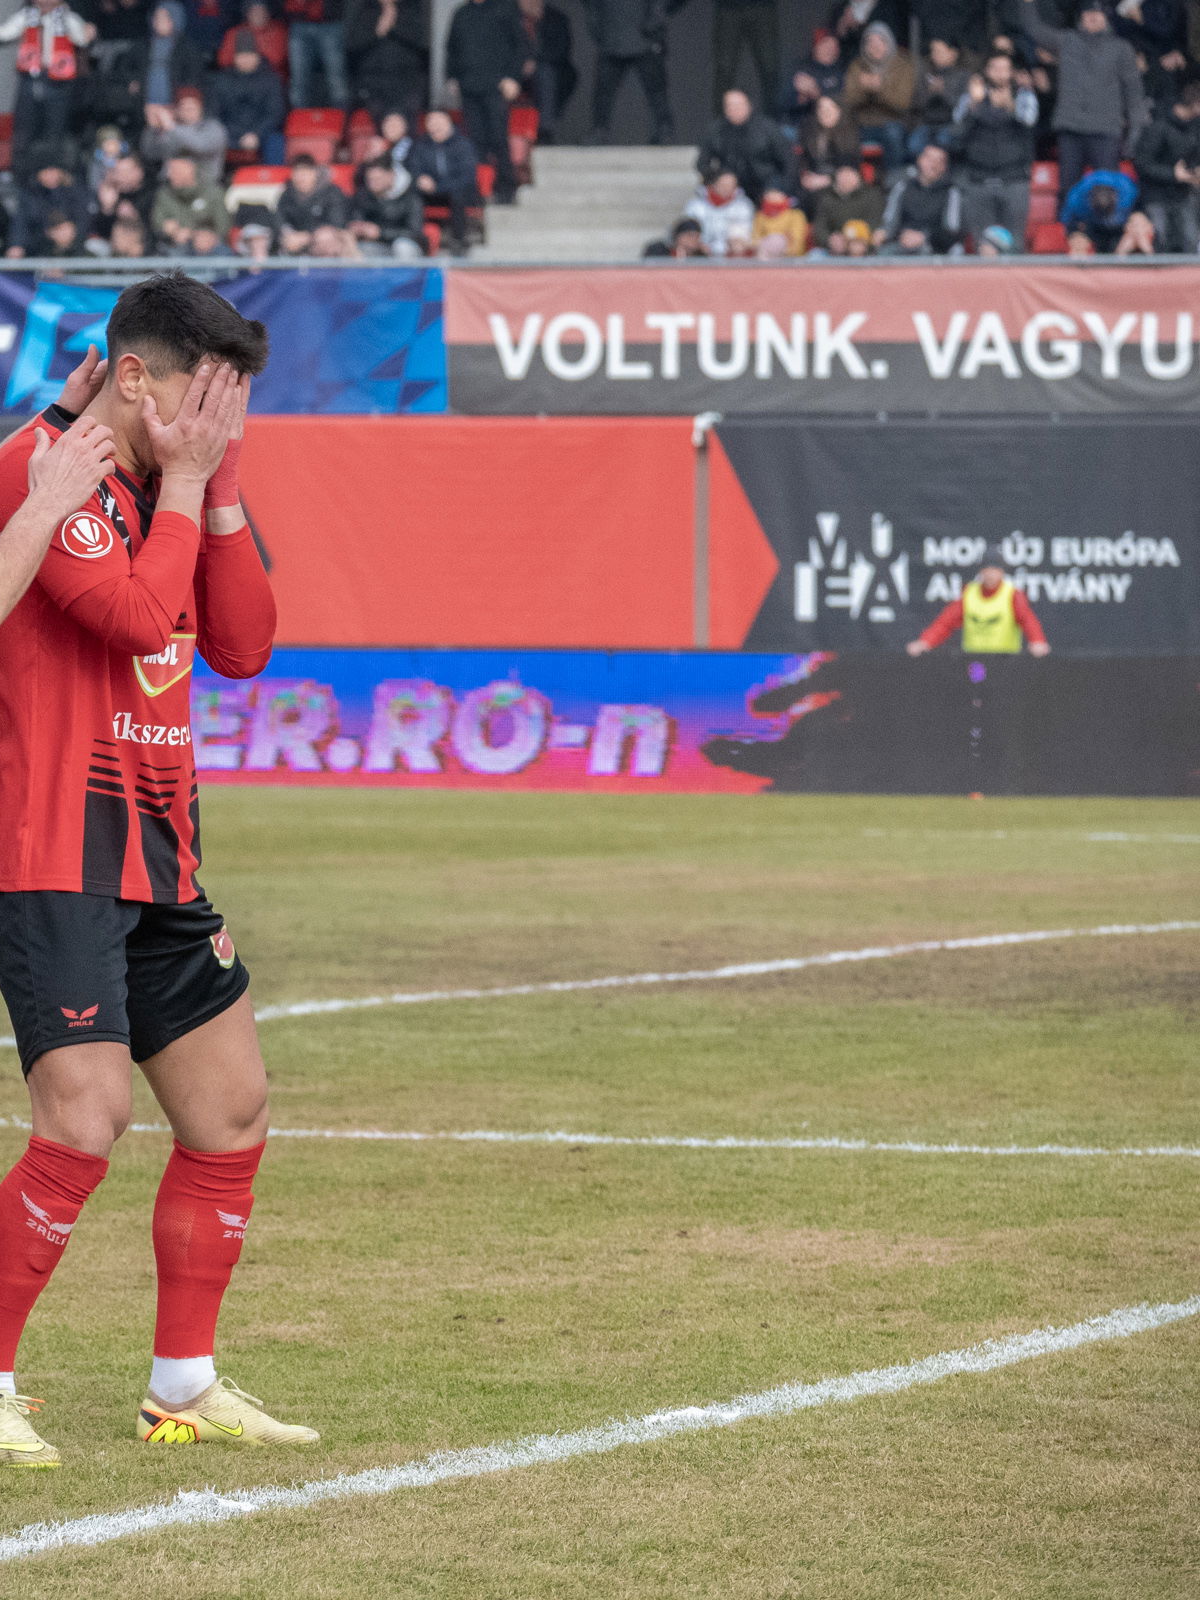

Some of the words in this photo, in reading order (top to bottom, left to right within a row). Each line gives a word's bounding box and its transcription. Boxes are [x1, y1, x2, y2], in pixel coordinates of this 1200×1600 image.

[489, 312, 888, 380] VOLTUNK.
[913, 312, 1194, 380] VAGYU
[1001, 530, 1044, 566] ÚJ
[1051, 530, 1180, 566] EURÓPA
[67, 1018, 95, 1028] 2RULE
